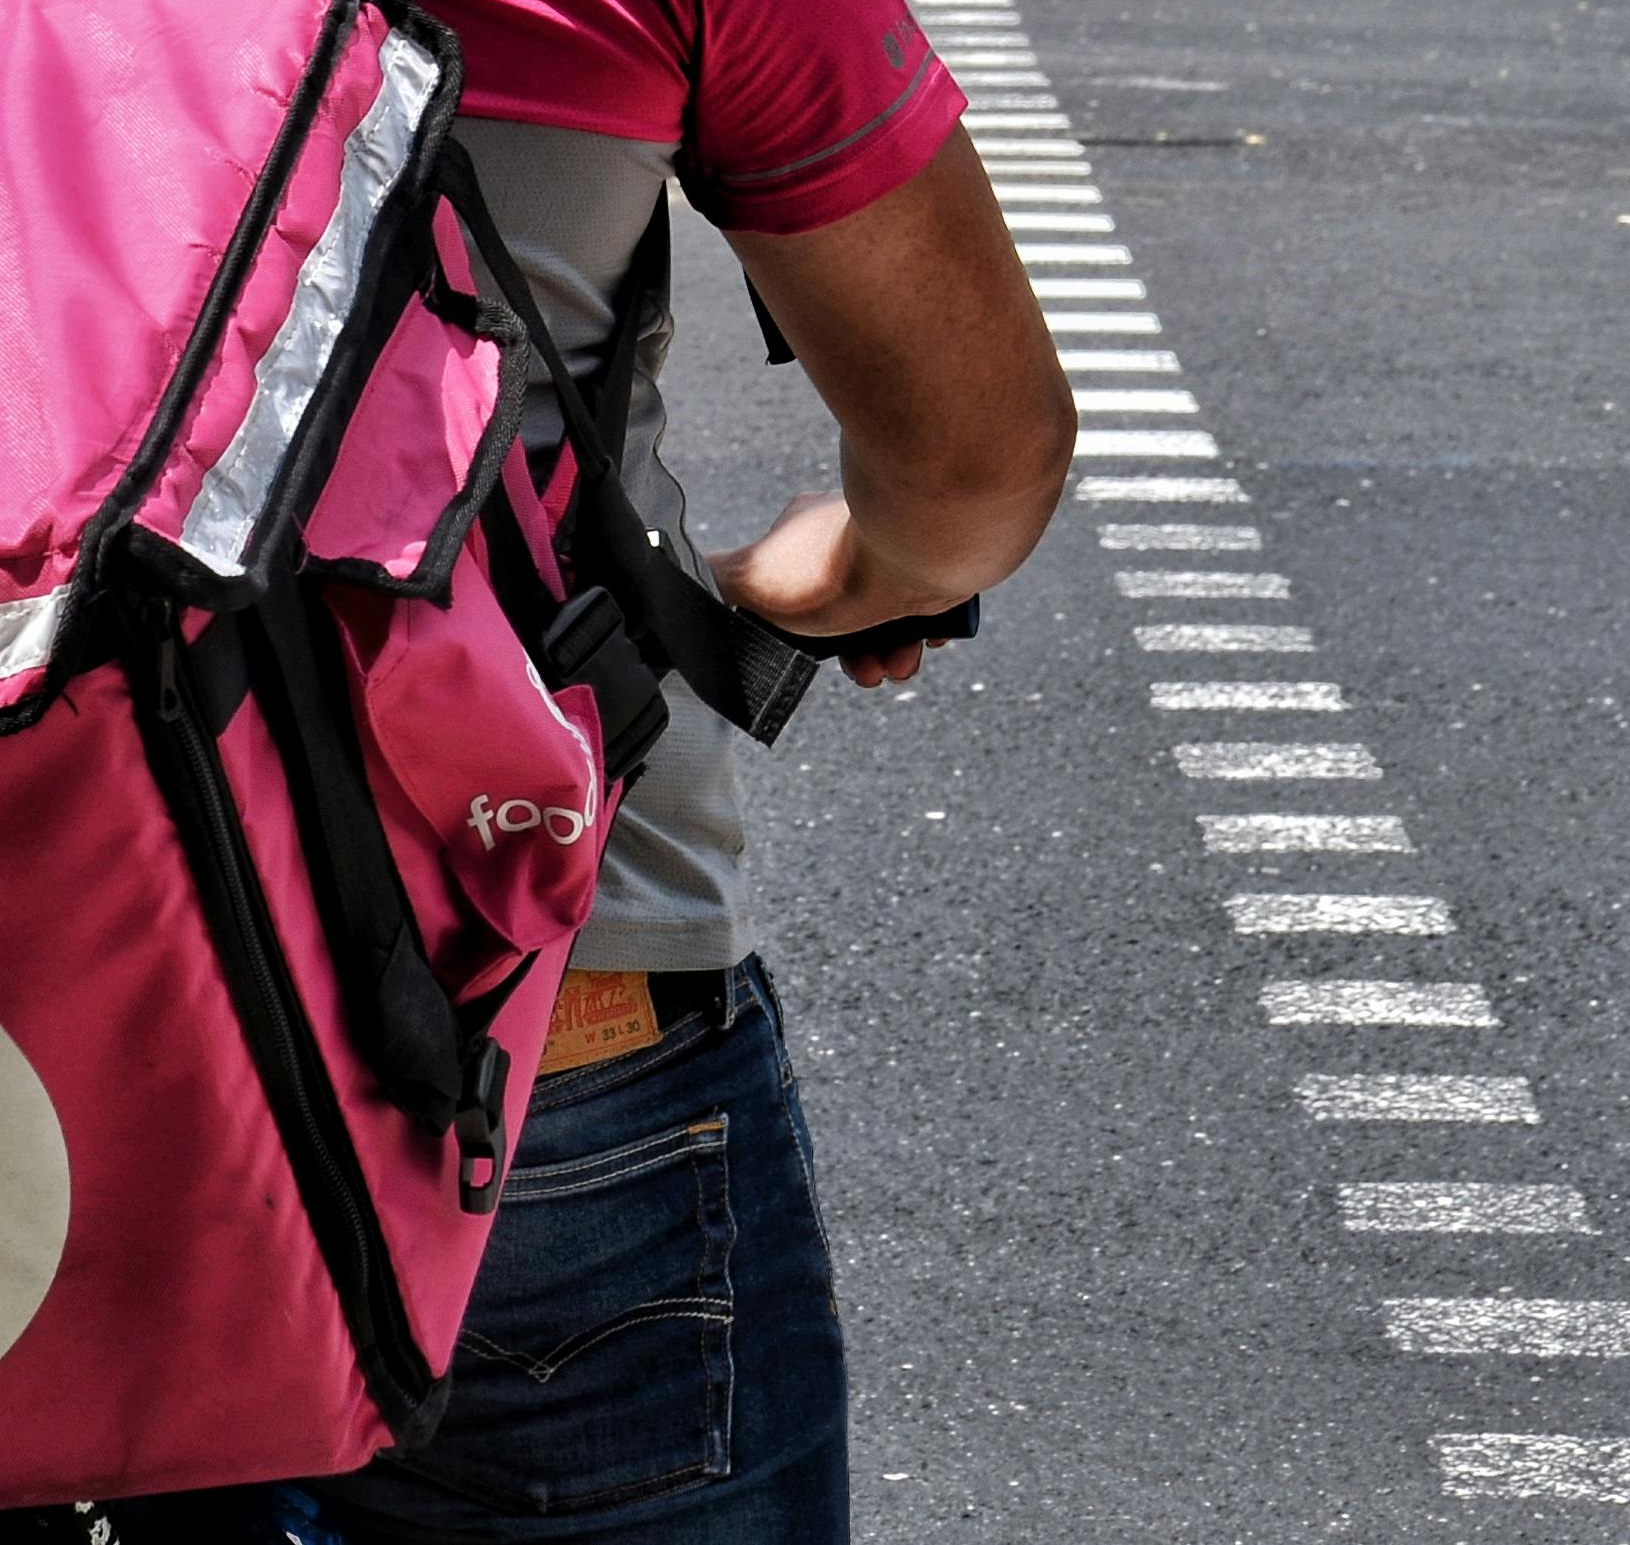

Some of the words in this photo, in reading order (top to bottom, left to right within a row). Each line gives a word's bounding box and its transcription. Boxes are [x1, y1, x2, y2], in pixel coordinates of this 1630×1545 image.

[585, 1032, 596, 1044] W
[602, 1027, 616, 1041] 33
[618, 1024, 624, 1035] L
[626, 1019, 640, 1033] 30
